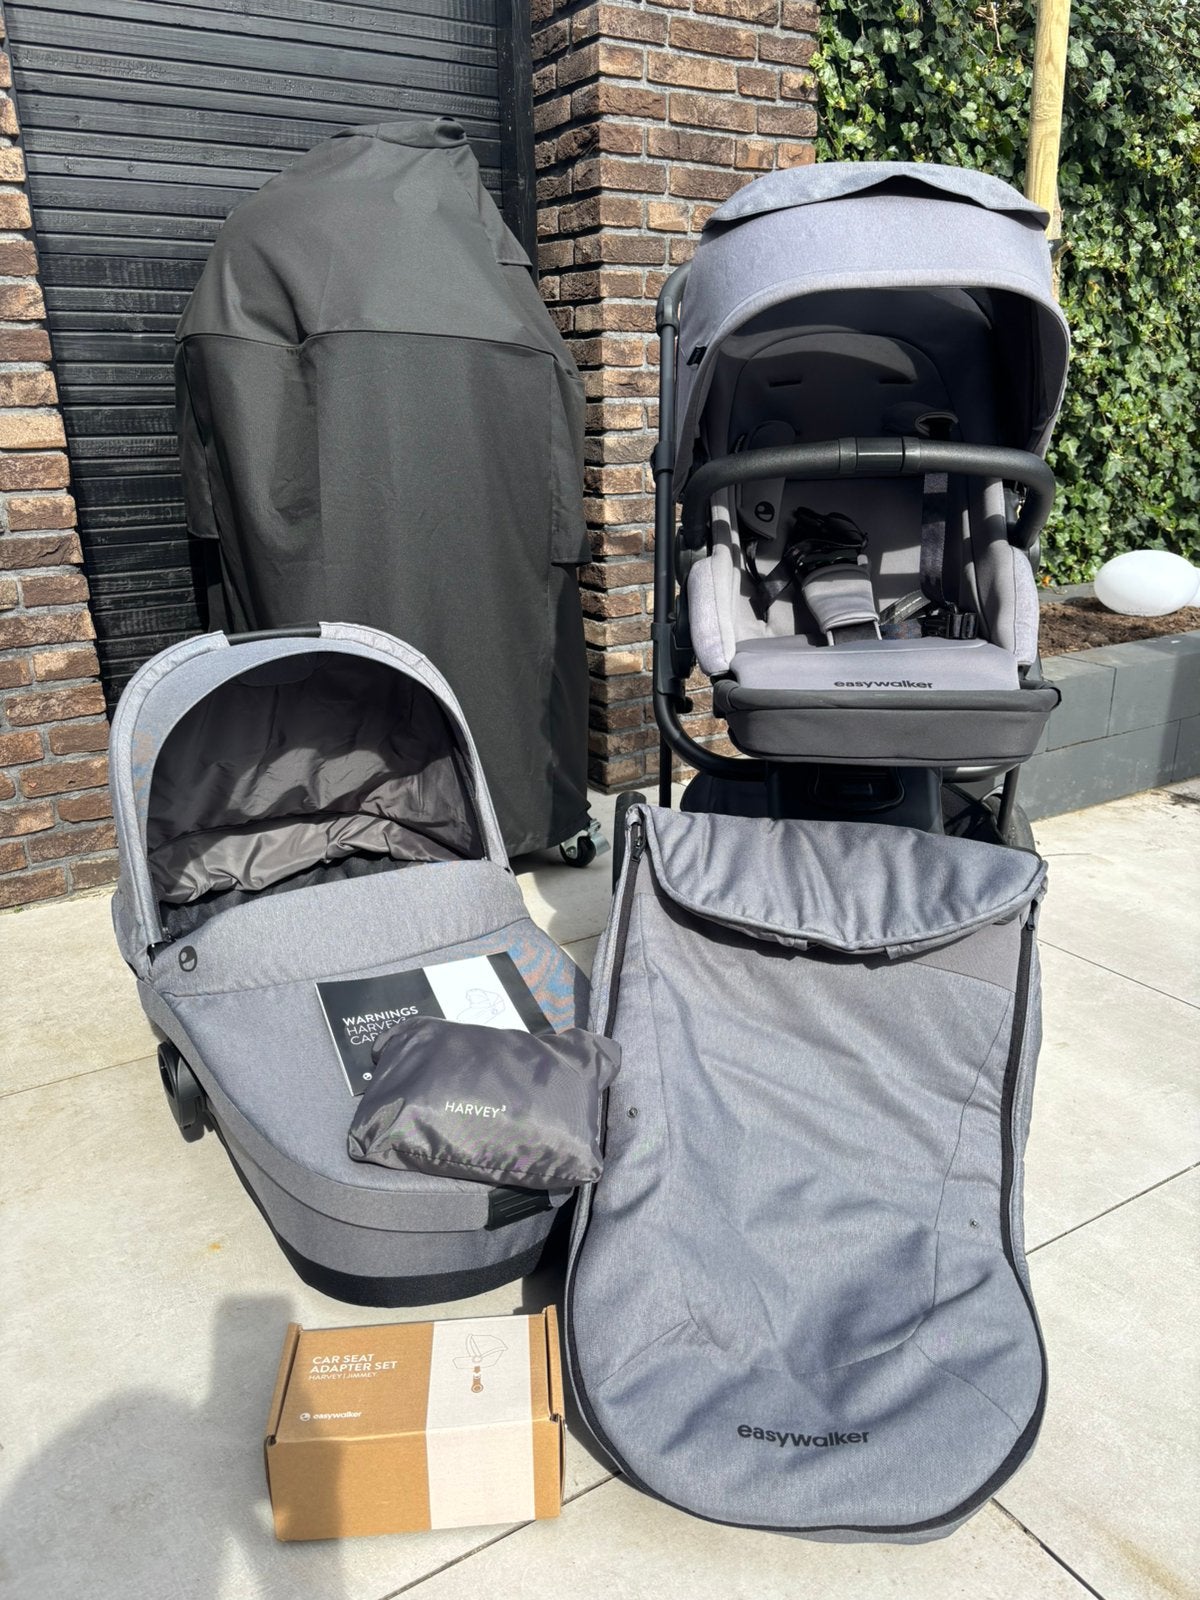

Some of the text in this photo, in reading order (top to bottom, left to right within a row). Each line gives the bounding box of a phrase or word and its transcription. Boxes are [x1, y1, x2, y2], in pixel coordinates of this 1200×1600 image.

[834, 680, 933, 689] easywalker
[342, 1005, 419, 1026] WARNINGS
[312, 1353, 375, 1365] CAR SEAT
[310, 1360, 398, 1374] ADAPTER SET
[312, 1411, 363, 1420] easywalker
[737, 1424, 870, 1448] easywalker
